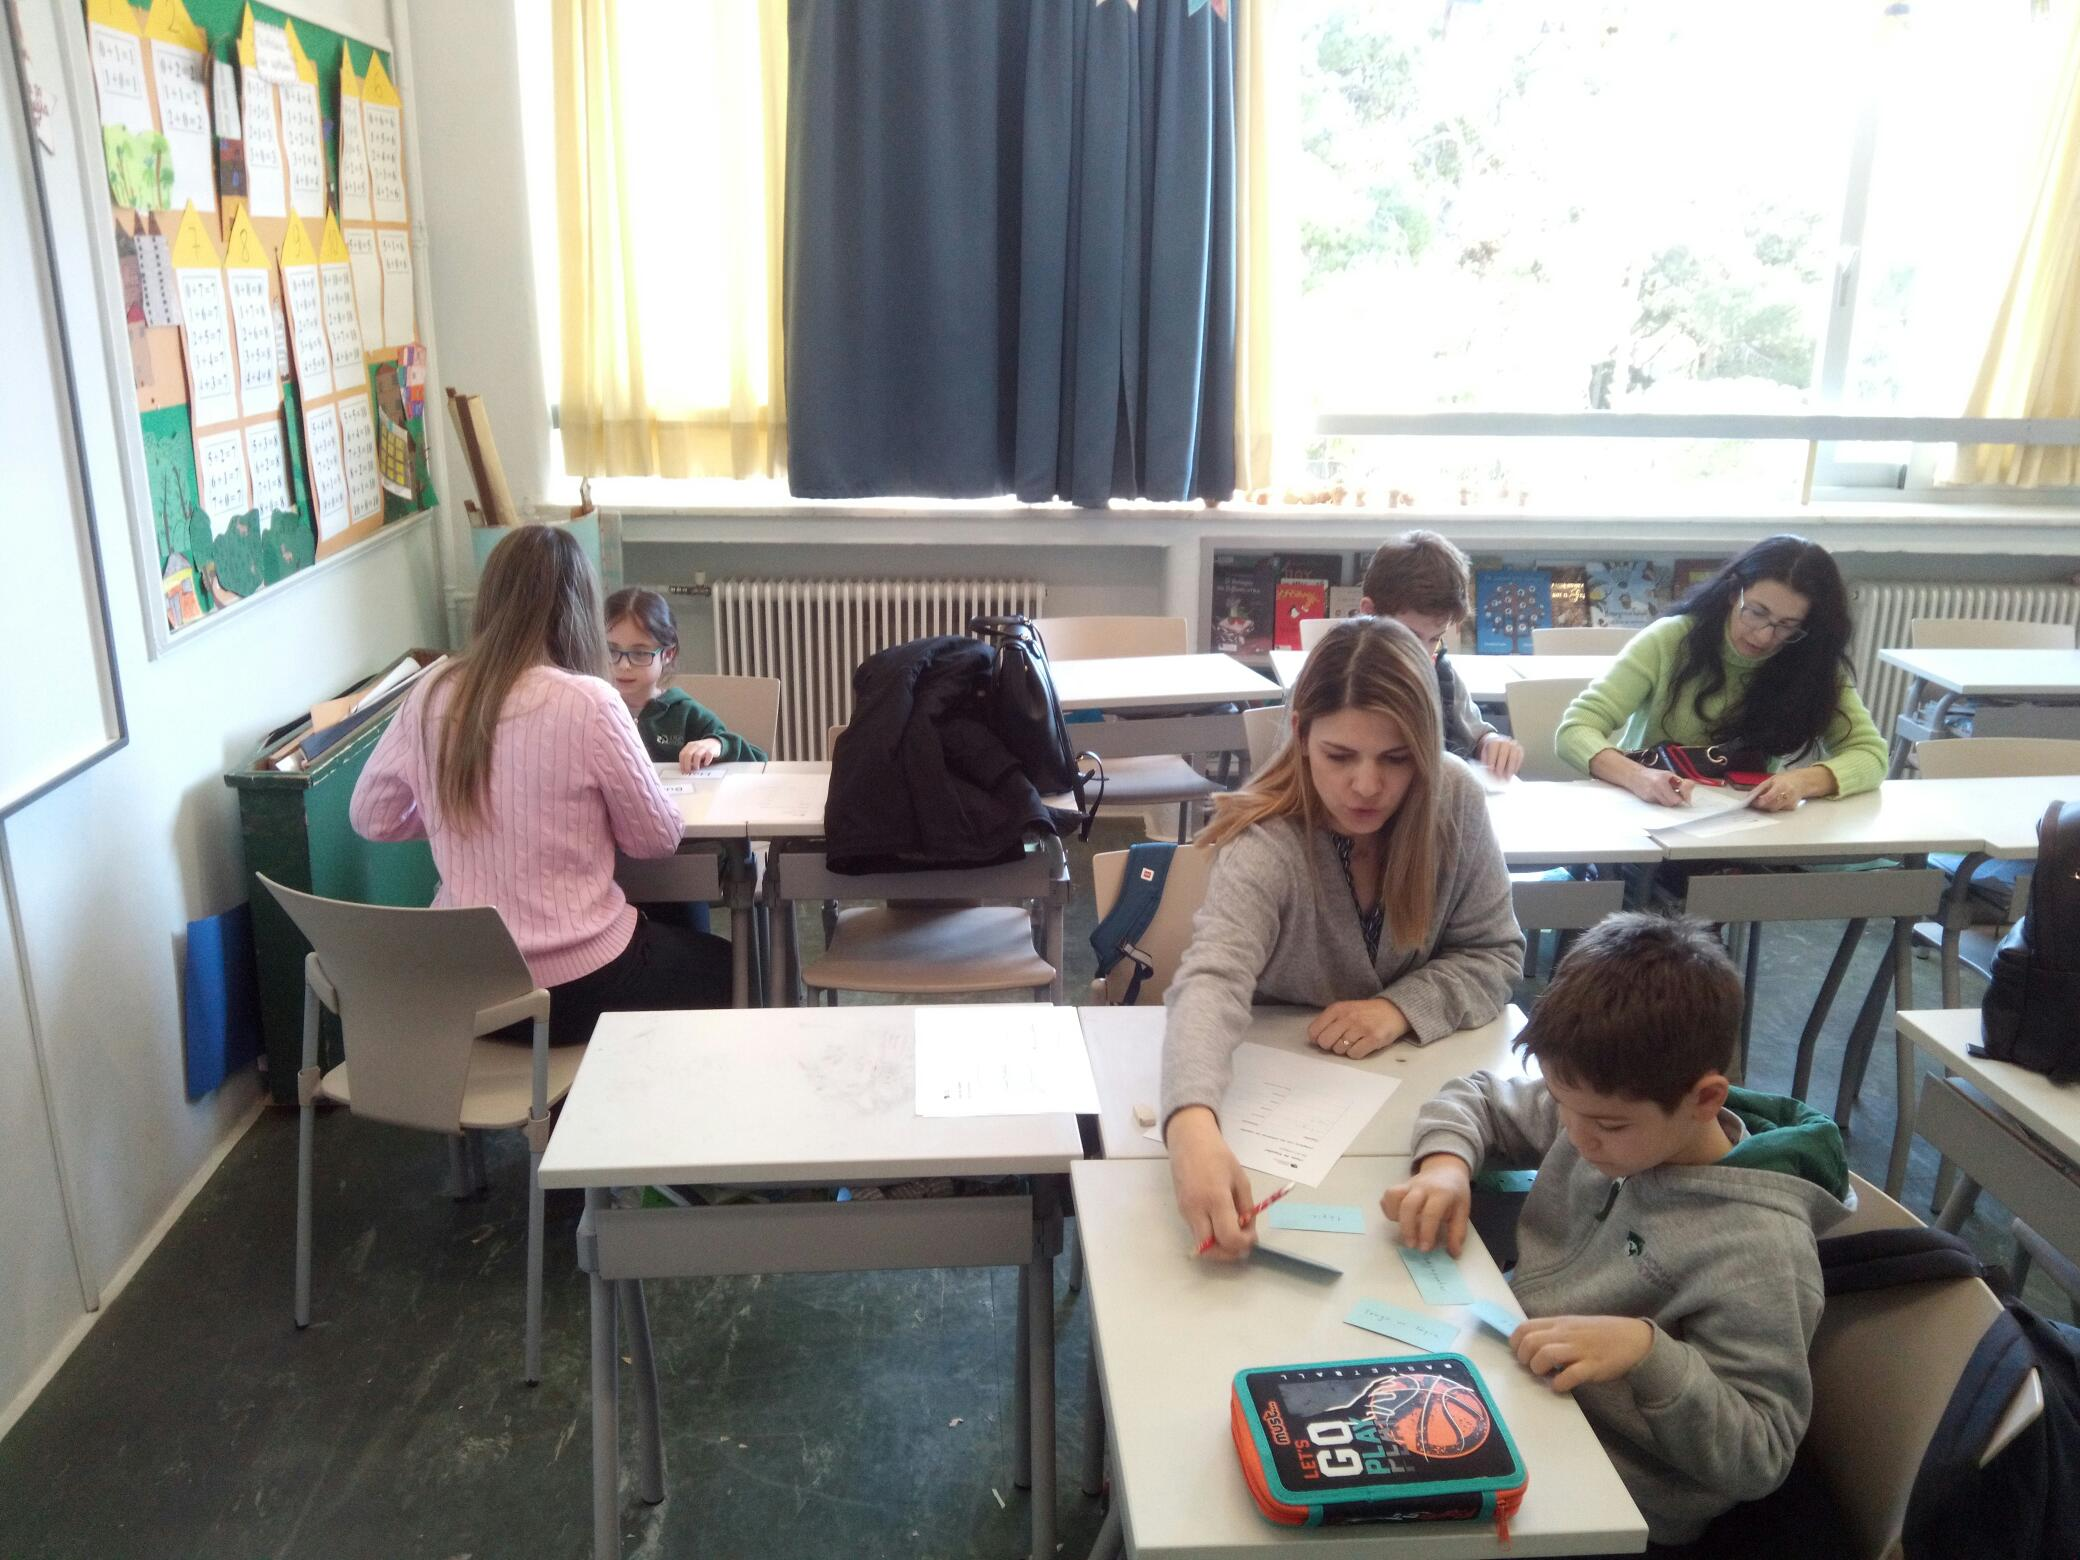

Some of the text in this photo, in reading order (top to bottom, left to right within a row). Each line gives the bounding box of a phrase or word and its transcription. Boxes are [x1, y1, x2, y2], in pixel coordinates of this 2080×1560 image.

[1280, 1363, 1453, 1381] BASKETBALL
[1295, 1440, 1320, 1479] LET'S
[1306, 1420, 1363, 1477] GO
[1349, 1417, 1392, 1475] PLAY
